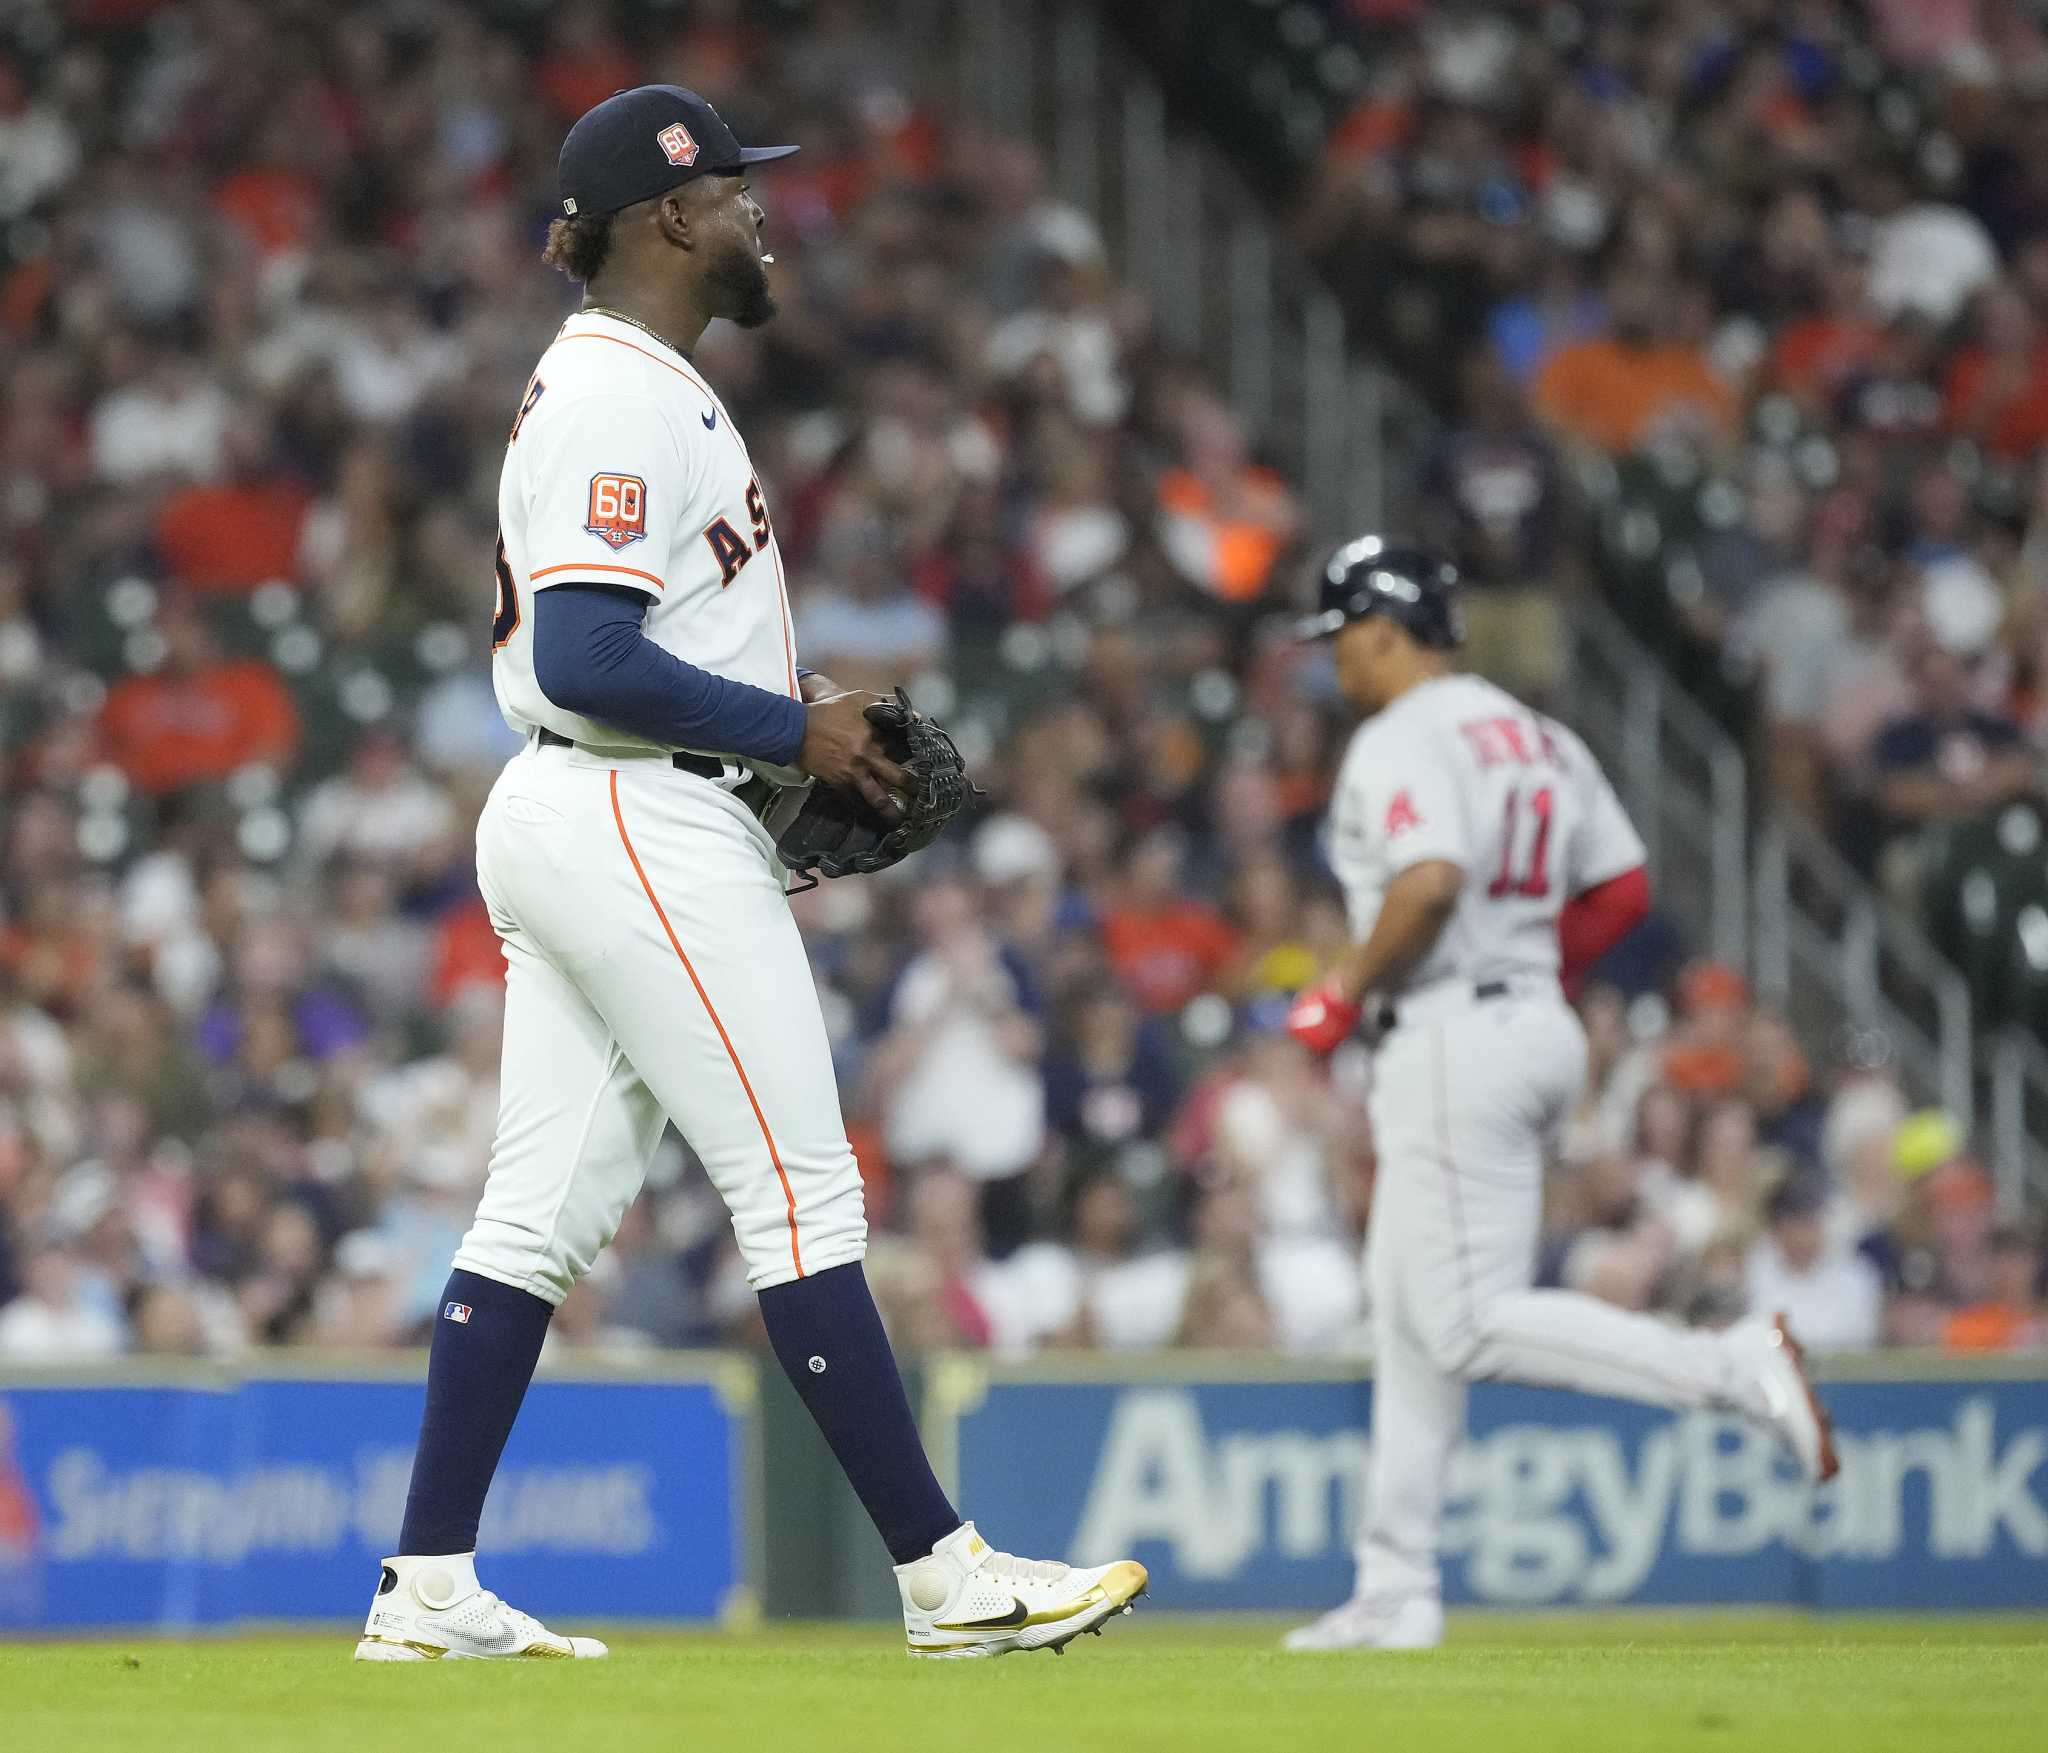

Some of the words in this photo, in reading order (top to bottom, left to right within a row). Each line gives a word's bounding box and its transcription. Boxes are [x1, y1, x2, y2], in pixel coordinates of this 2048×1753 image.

[662, 127, 691, 155] 60
[595, 479, 641, 522] 60
[1487, 785, 1553, 899] 11
